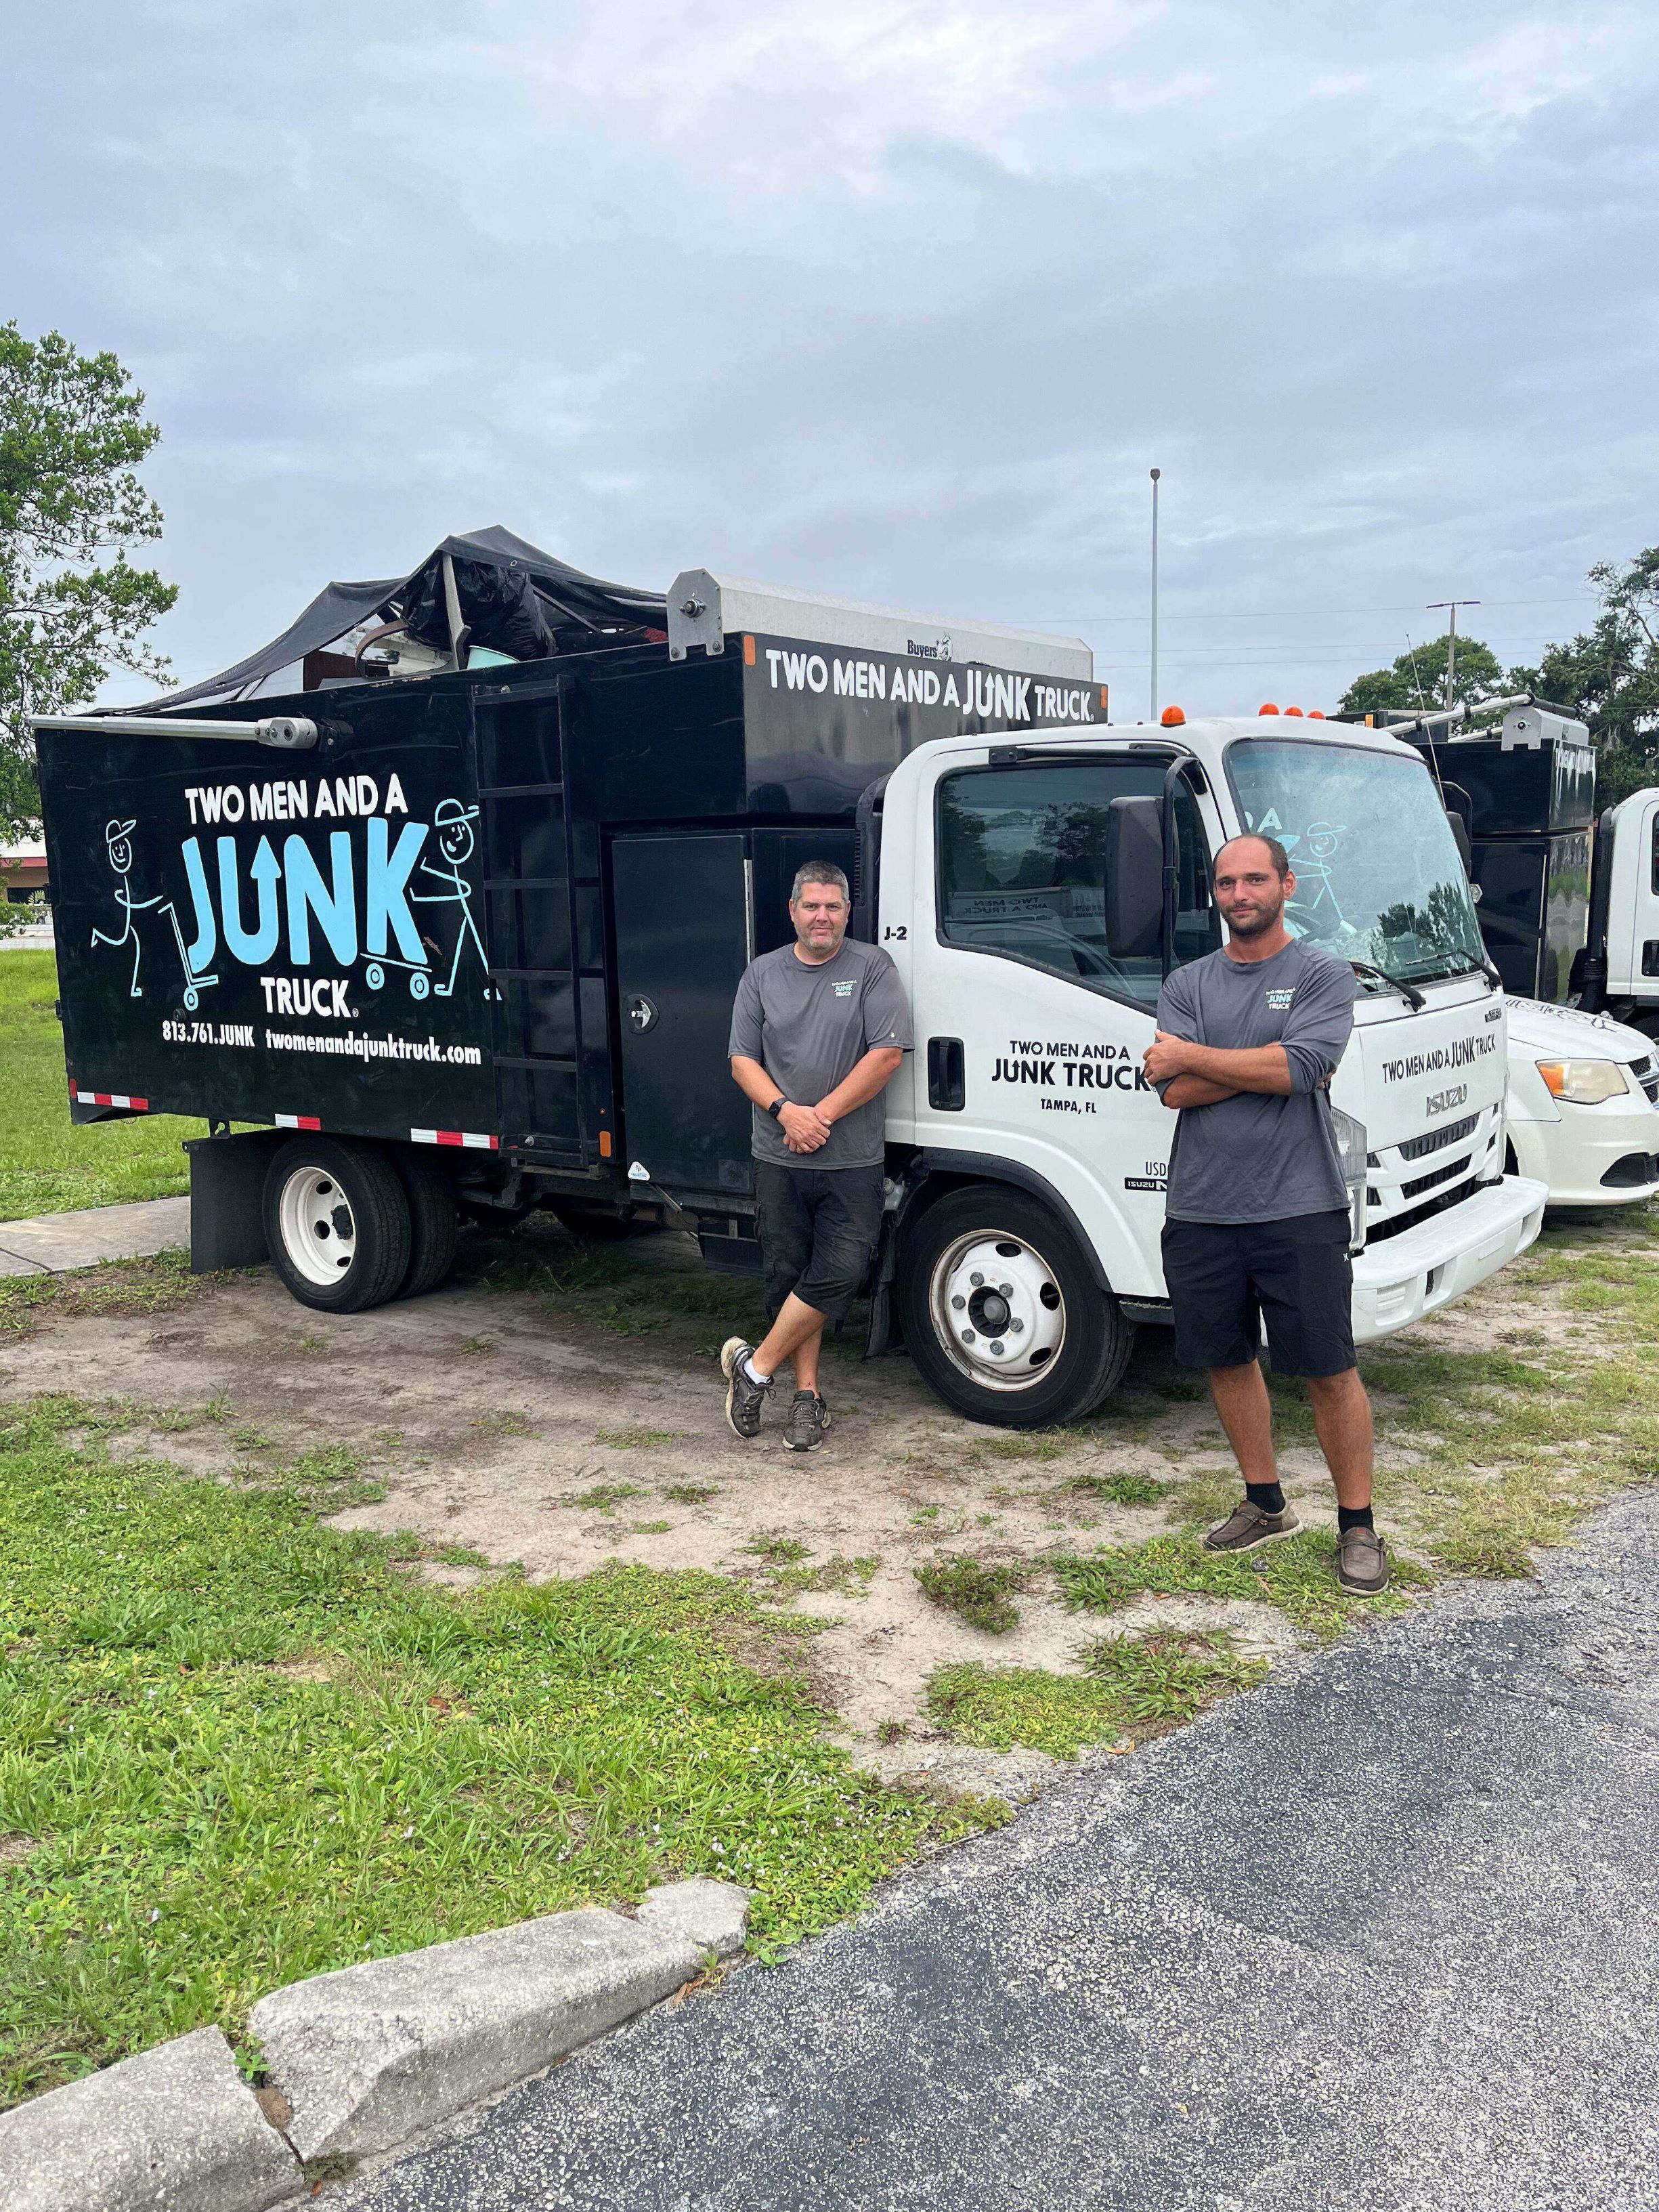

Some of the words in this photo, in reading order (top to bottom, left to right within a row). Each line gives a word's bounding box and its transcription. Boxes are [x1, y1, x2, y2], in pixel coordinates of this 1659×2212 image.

[907, 639, 937, 658] Buyers
[766, 649, 828, 694] TWO
[834, 658, 886, 700] MEN
[890, 666, 941, 705] AND
[943, 673, 960, 708] A
[963, 669, 1031, 721] JUNK
[185, 785, 244, 824] TWO
[249, 780, 308, 822] MEN
[314, 775, 379, 817] AND
[385, 773, 408, 814] A
[181, 817, 429, 974] JUNK
[884, 926, 907, 940] J-2
[1268, 994, 1292, 1003] JUNK
[163, 1020, 255, 1047] 813.761.JUNK
[265, 1029, 481, 1065] twomenandajunktruck.com
[1010, 1040, 1043, 1055] TWO
[1047, 1042, 1079, 1057] MEN
[1081, 1044, 1117, 1059] AND
[1118, 1046, 1131, 1060] A
[1382, 1059, 1404, 1084] TWO
[1406, 1054, 1425, 1078] MEN
[1426, 1050, 1444, 1073] AND
[1444, 1048, 1450, 1067] A
[1451, 1036, 1475, 1069] JUNK
[1476, 1033, 1496, 1056] TRUCK
[991, 1058, 1056, 1086] JUNK
[1063, 1062, 1152, 1091] TRUCK
[1040, 1098, 1081, 1114] TAMPA,
[1085, 1102, 1097, 1113] FL
[1426, 1084, 1467, 1117] ISUZU
[1127, 1181, 1155, 1189] ISUZU
